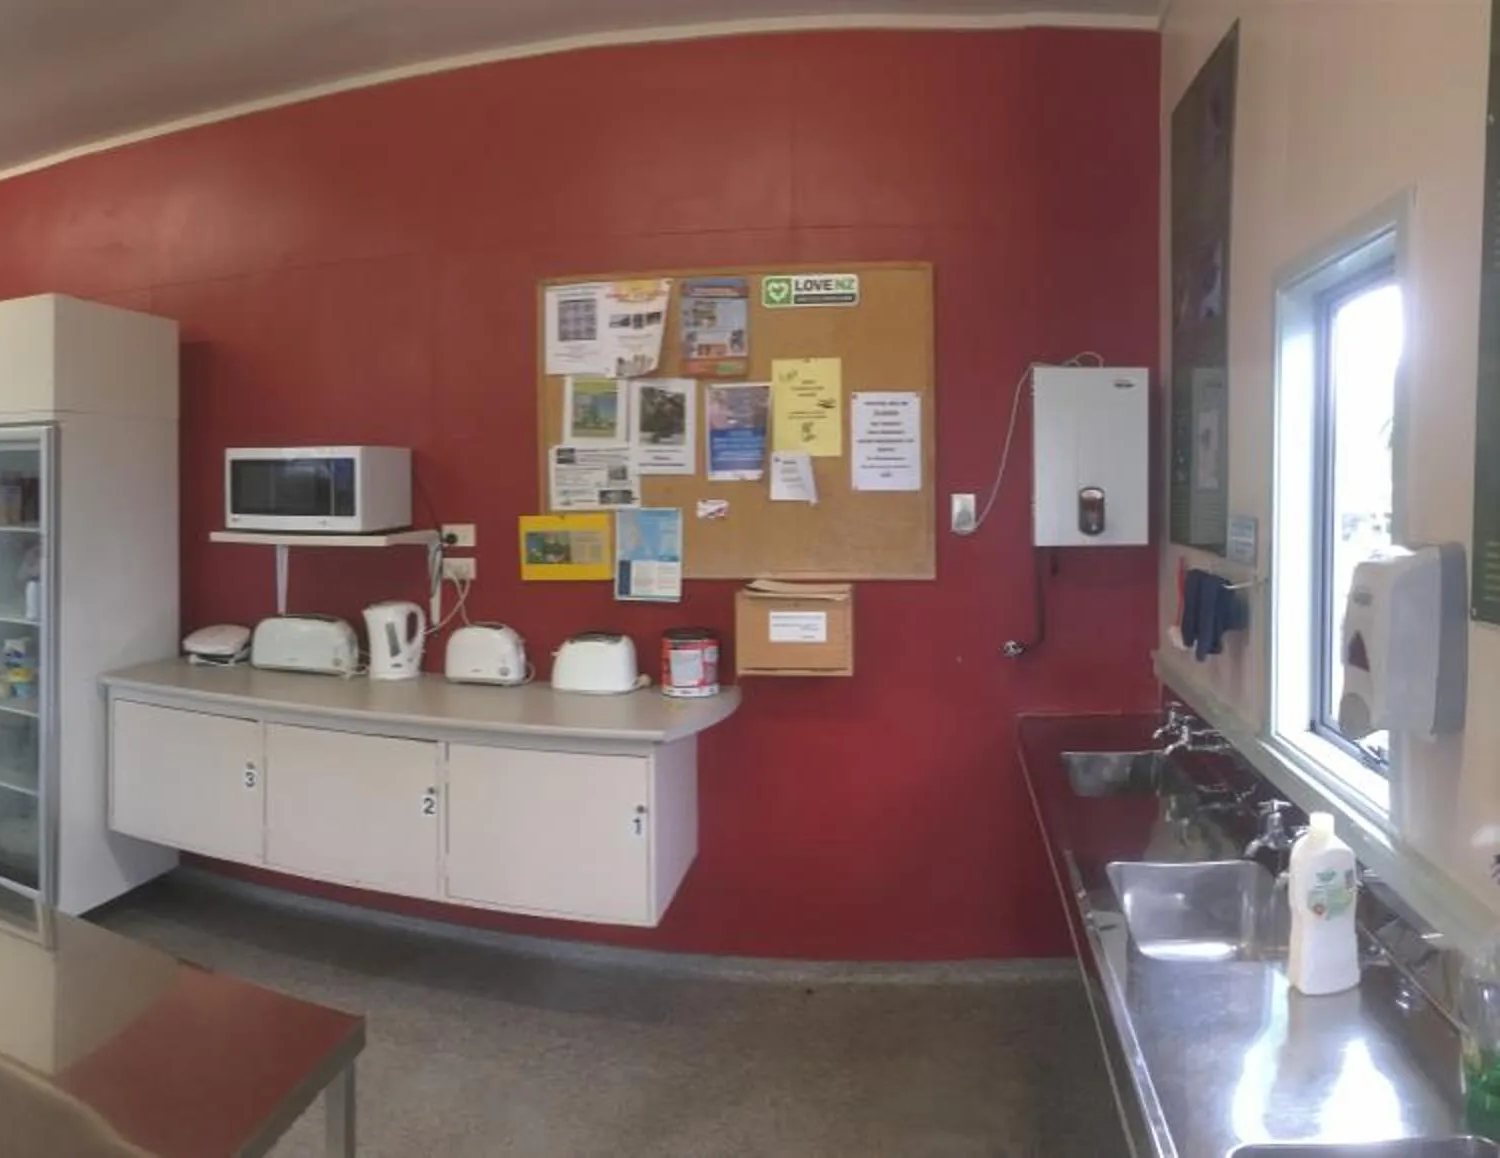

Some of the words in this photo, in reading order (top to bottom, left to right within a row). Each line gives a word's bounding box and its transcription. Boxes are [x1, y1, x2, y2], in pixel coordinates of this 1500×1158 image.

[795, 279, 832, 291] LOVE
[835, 278, 854, 290] NZ
[245, 771, 256, 788] 3
[423, 797, 436, 815] 2
[632, 816, 642, 836] 1
